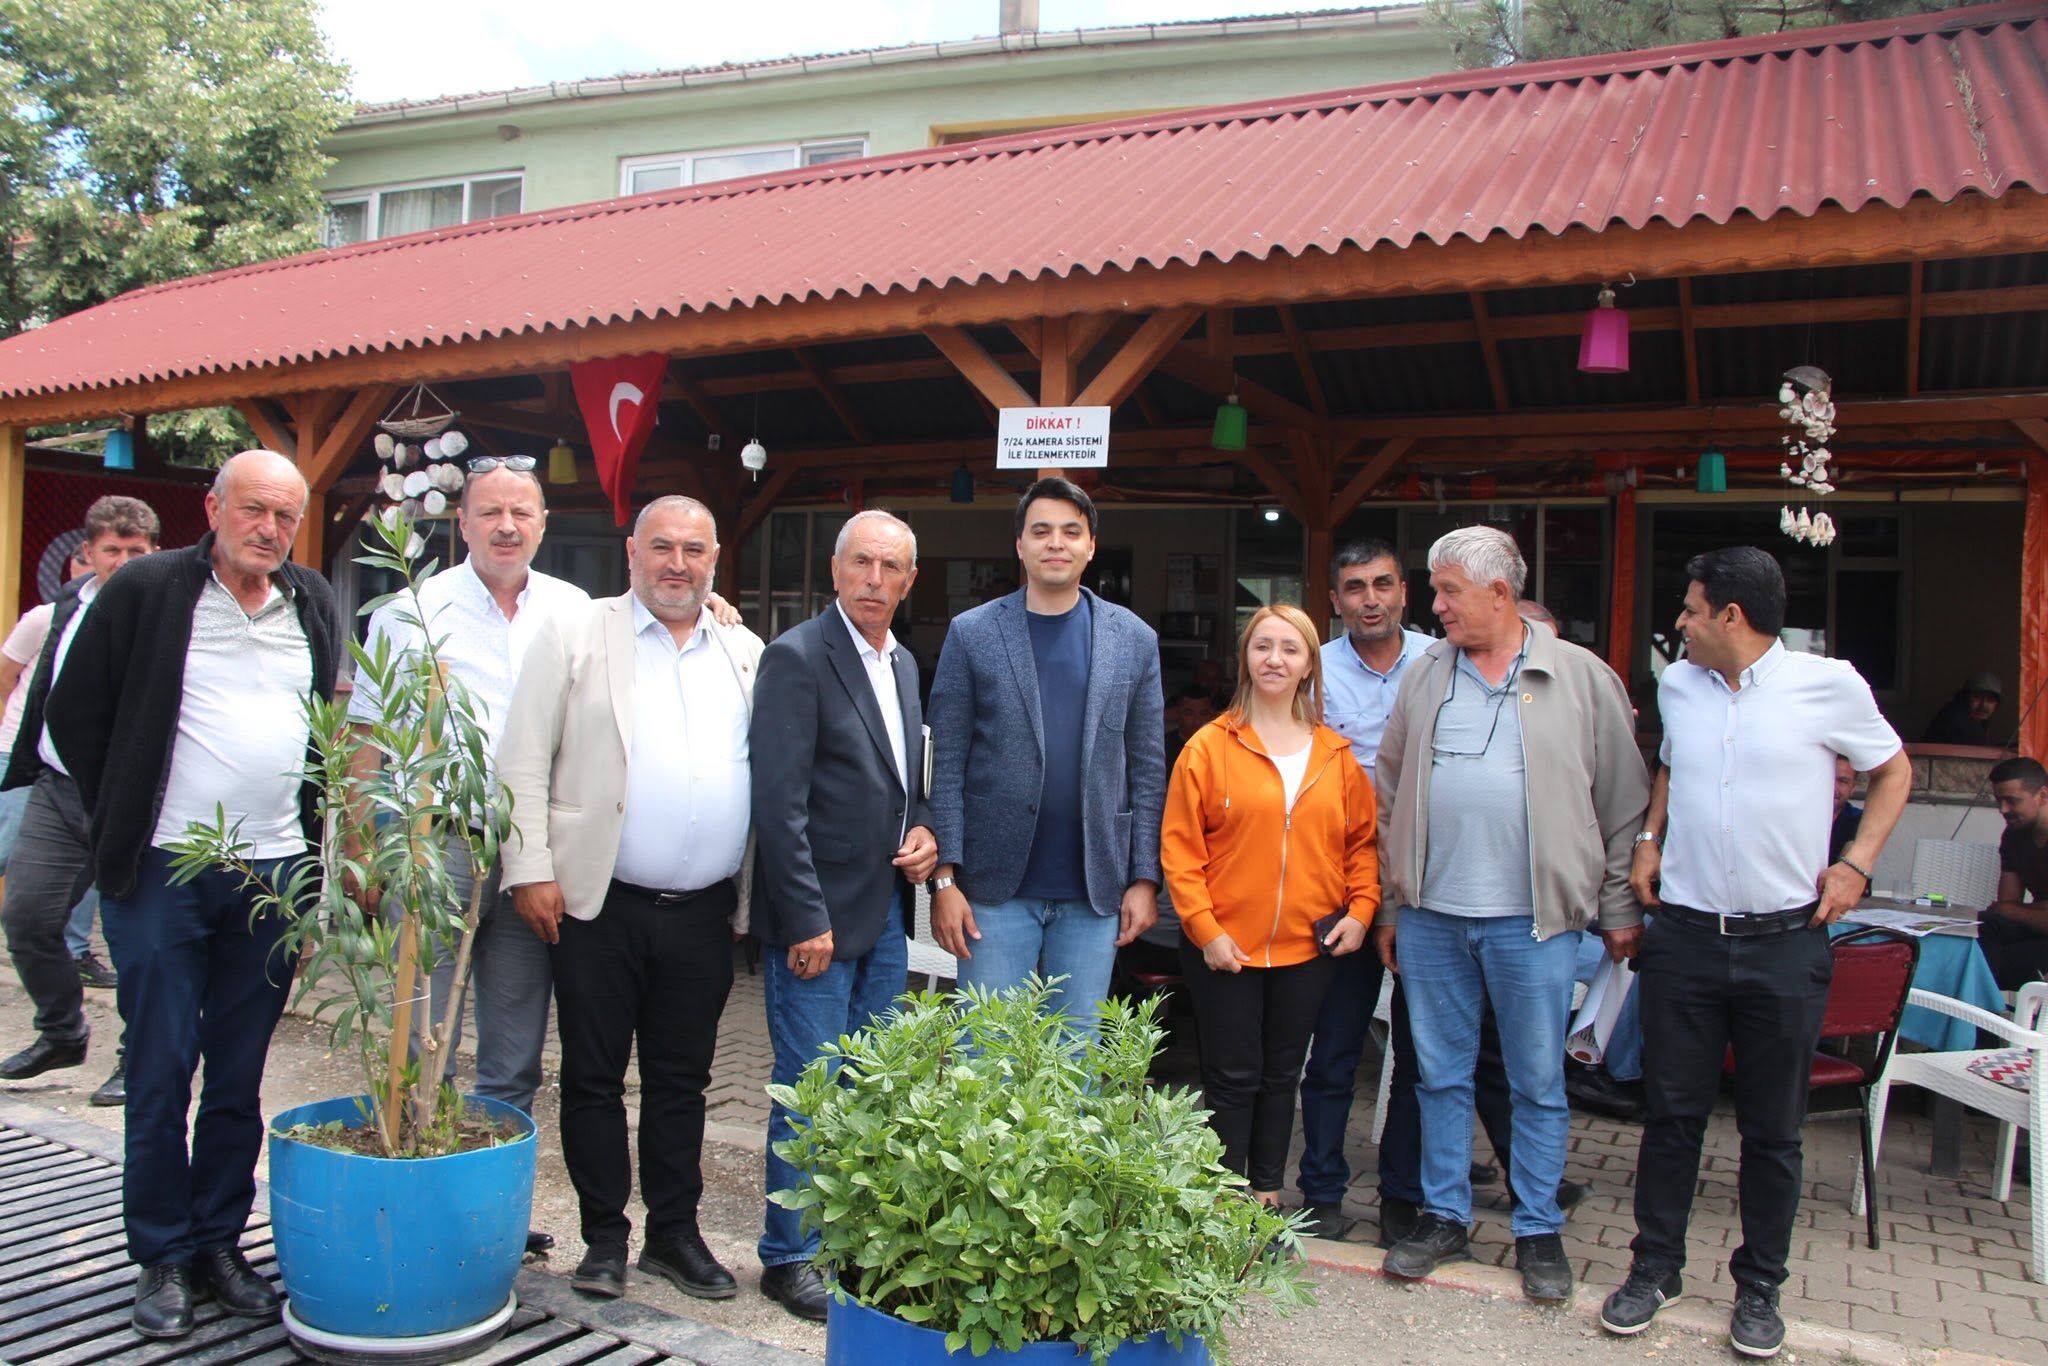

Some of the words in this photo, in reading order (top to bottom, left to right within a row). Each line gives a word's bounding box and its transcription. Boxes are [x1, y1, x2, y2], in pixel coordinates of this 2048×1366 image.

[1026, 416, 1072, 430] DİKKAT
[1003, 437, 1023, 446] 7/24
[1025, 437, 1063, 446] KAMERA
[1066, 435, 1102, 446] SİSTEMİ
[1008, 449, 1021, 459] İLE
[1024, 449, 1096, 459] İZLENMEKTEDİR
